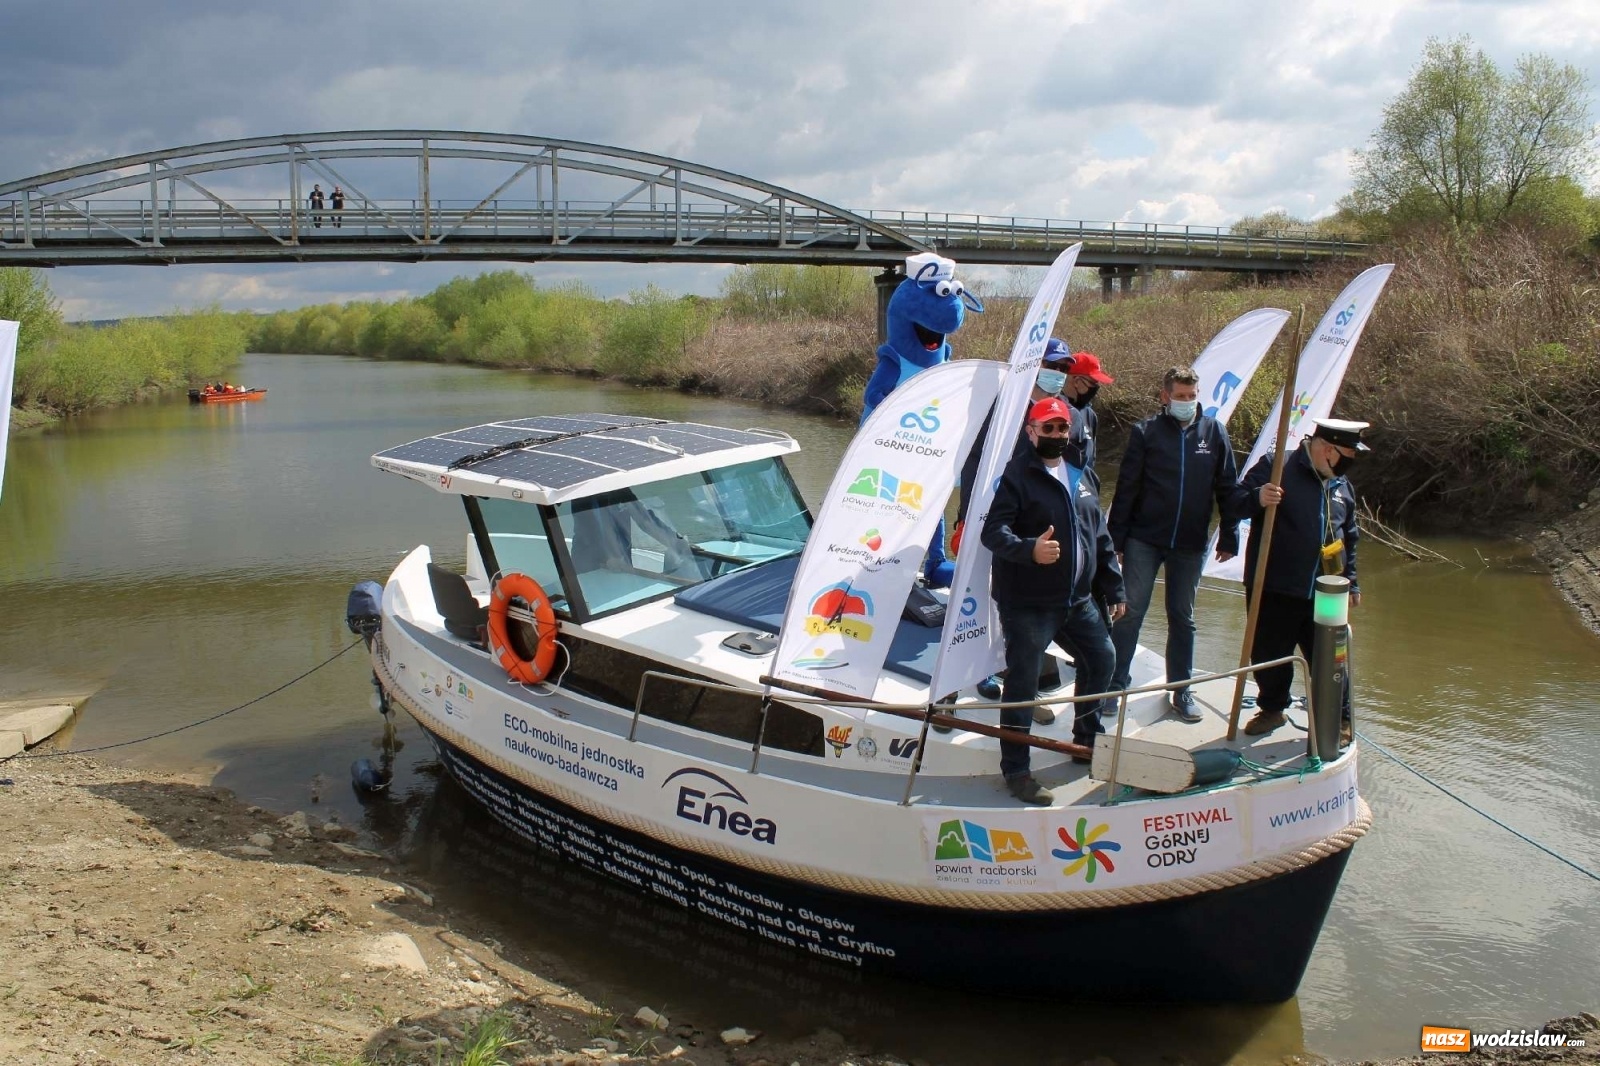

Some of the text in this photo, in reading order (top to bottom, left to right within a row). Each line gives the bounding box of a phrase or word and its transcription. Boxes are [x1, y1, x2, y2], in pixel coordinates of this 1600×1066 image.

[894, 430, 933, 446] KRAINA
[915, 446, 947, 457] ODRY
[842, 496, 876, 508] powiat
[955, 618, 978, 633] RAINA
[504, 713, 645, 779] ECO-mobilna jednostka
[504, 736, 619, 792] naukowo-badawcza
[676, 786, 777, 845] Enea
[1143, 806, 1233, 834] FESTIWAL
[1269, 784, 1357, 828] www.kraina
[935, 864, 1037, 876] powiat raciborski
[1146, 847, 1198, 869] ODRY
[518, 806, 544, 826] Nowa
[613, 852, 654, 877] Gorzów
[699, 887, 754, 917] Kostrzyn
[757, 910, 782, 928] nad
[786, 920, 822, 943] Odrą
[837, 935, 896, 957] Gryfino
[605, 834, 672, 869] Krapkowice
[680, 865, 717, 888] Opole
[725, 882, 784, 912] Wrocław
[798, 908, 856, 933] Głogów
[561, 841, 595, 863] Gdynia
[603, 861, 643, 887] Gdańsk
[697, 901, 748, 929] Ostróda
[807, 942, 863, 967] Mazury
